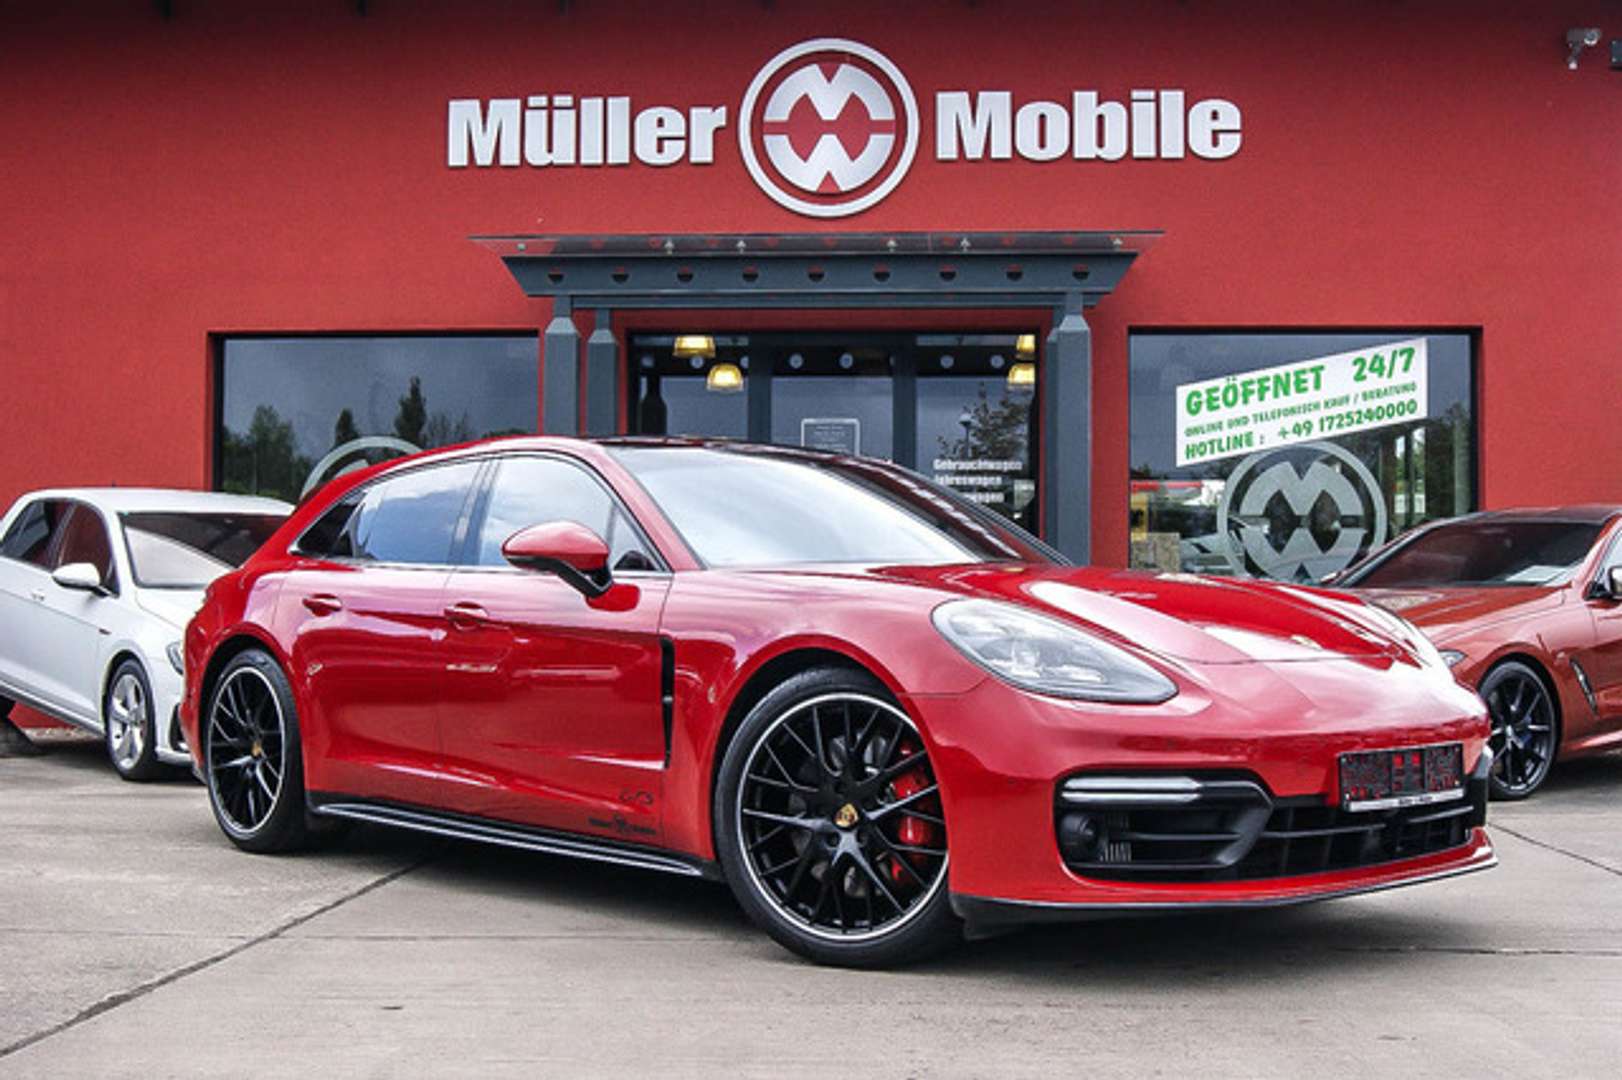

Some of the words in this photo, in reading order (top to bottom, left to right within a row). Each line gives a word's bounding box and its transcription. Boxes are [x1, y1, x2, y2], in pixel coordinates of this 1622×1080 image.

[448, 95, 727, 166] Müller
[936, 90, 1242, 160] Mobile
[1186, 365, 1325, 416] GEÖFFNET
[1353, 347, 1415, 382] 24/7
[1184, 421, 1223, 437] ONLINE
[1227, 416, 1250, 429] UND
[1185, 431, 1254, 459] HOTLINE
[1278, 420, 1314, 439] +49
[1319, 399, 1418, 432] 1725240000
